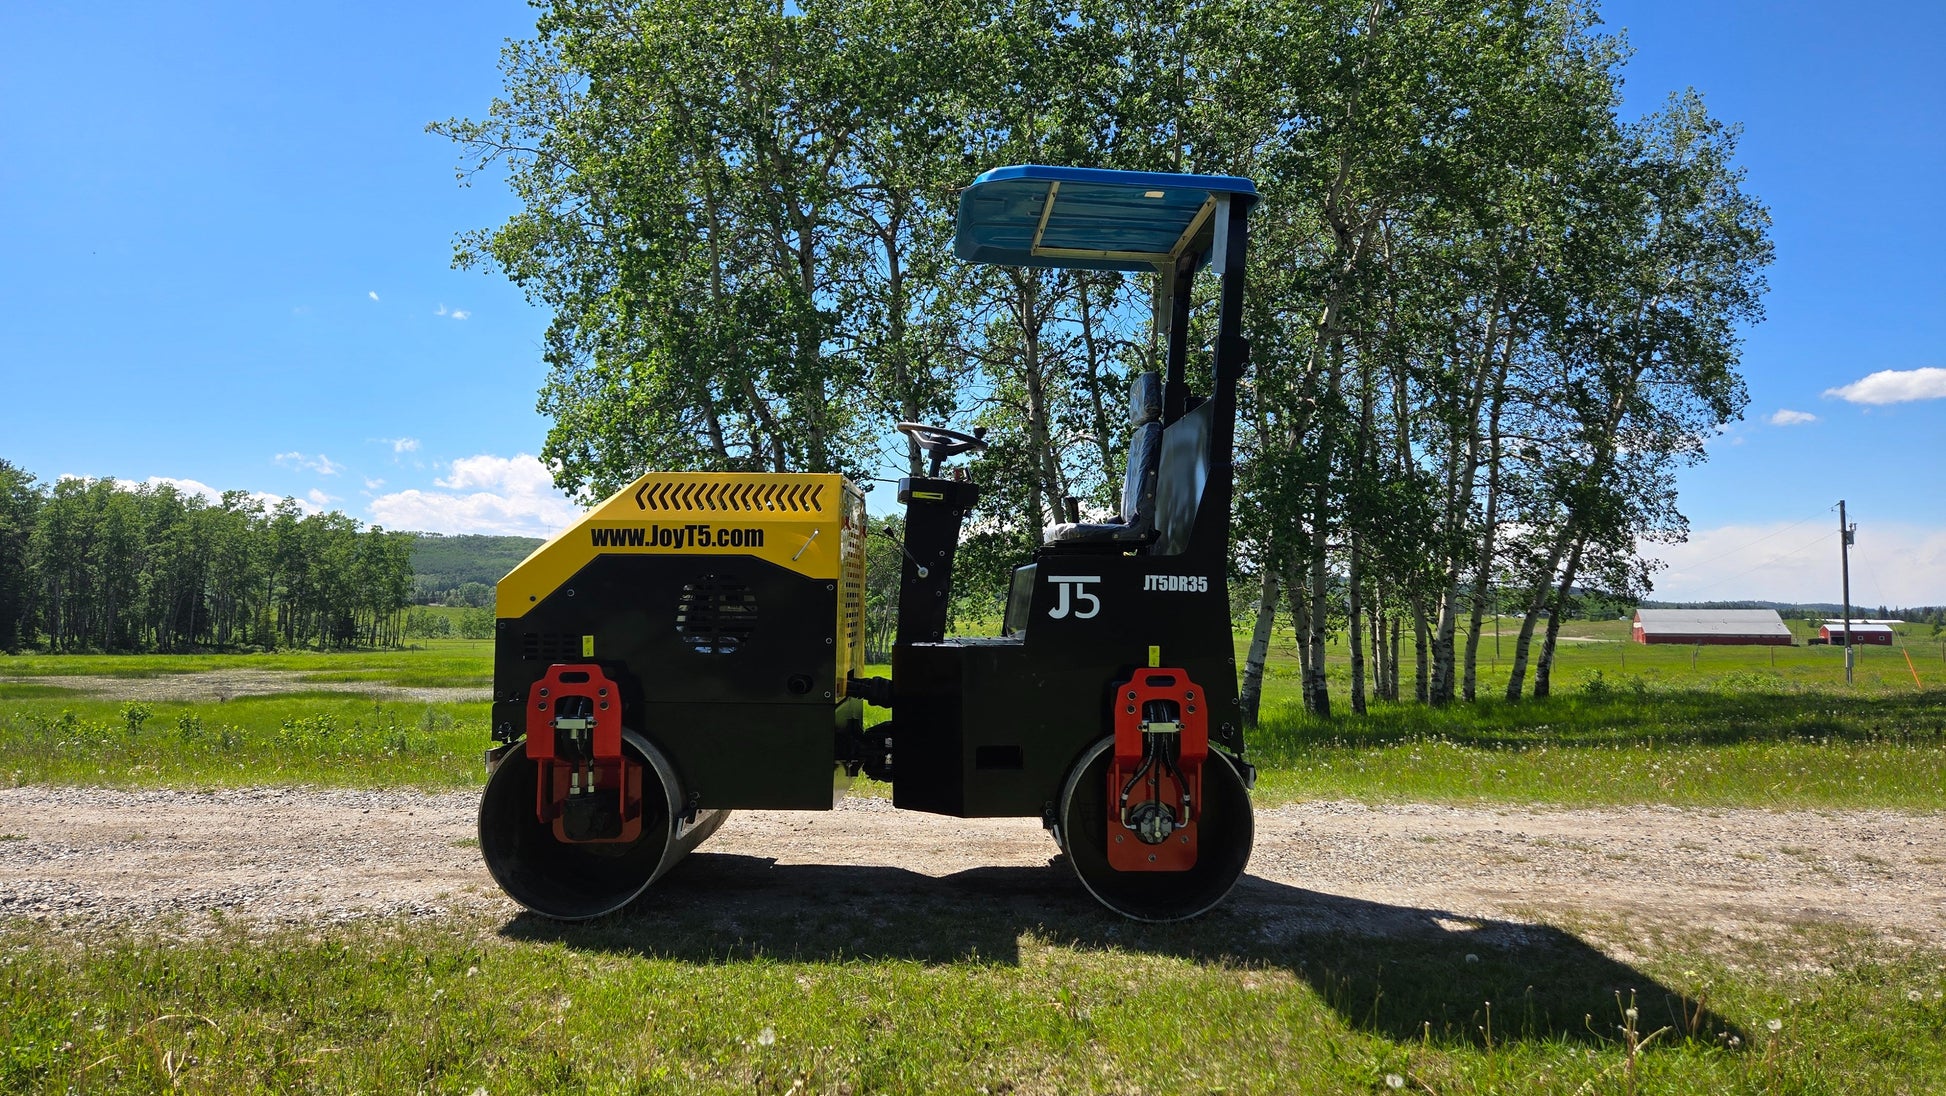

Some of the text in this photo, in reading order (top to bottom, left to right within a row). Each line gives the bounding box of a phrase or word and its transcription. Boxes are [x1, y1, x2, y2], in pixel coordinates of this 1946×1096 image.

[591, 525, 764, 549] www.JoyT5.com
[1143, 575, 1208, 592] JT5DR35
[1048, 575, 1101, 618] J5
